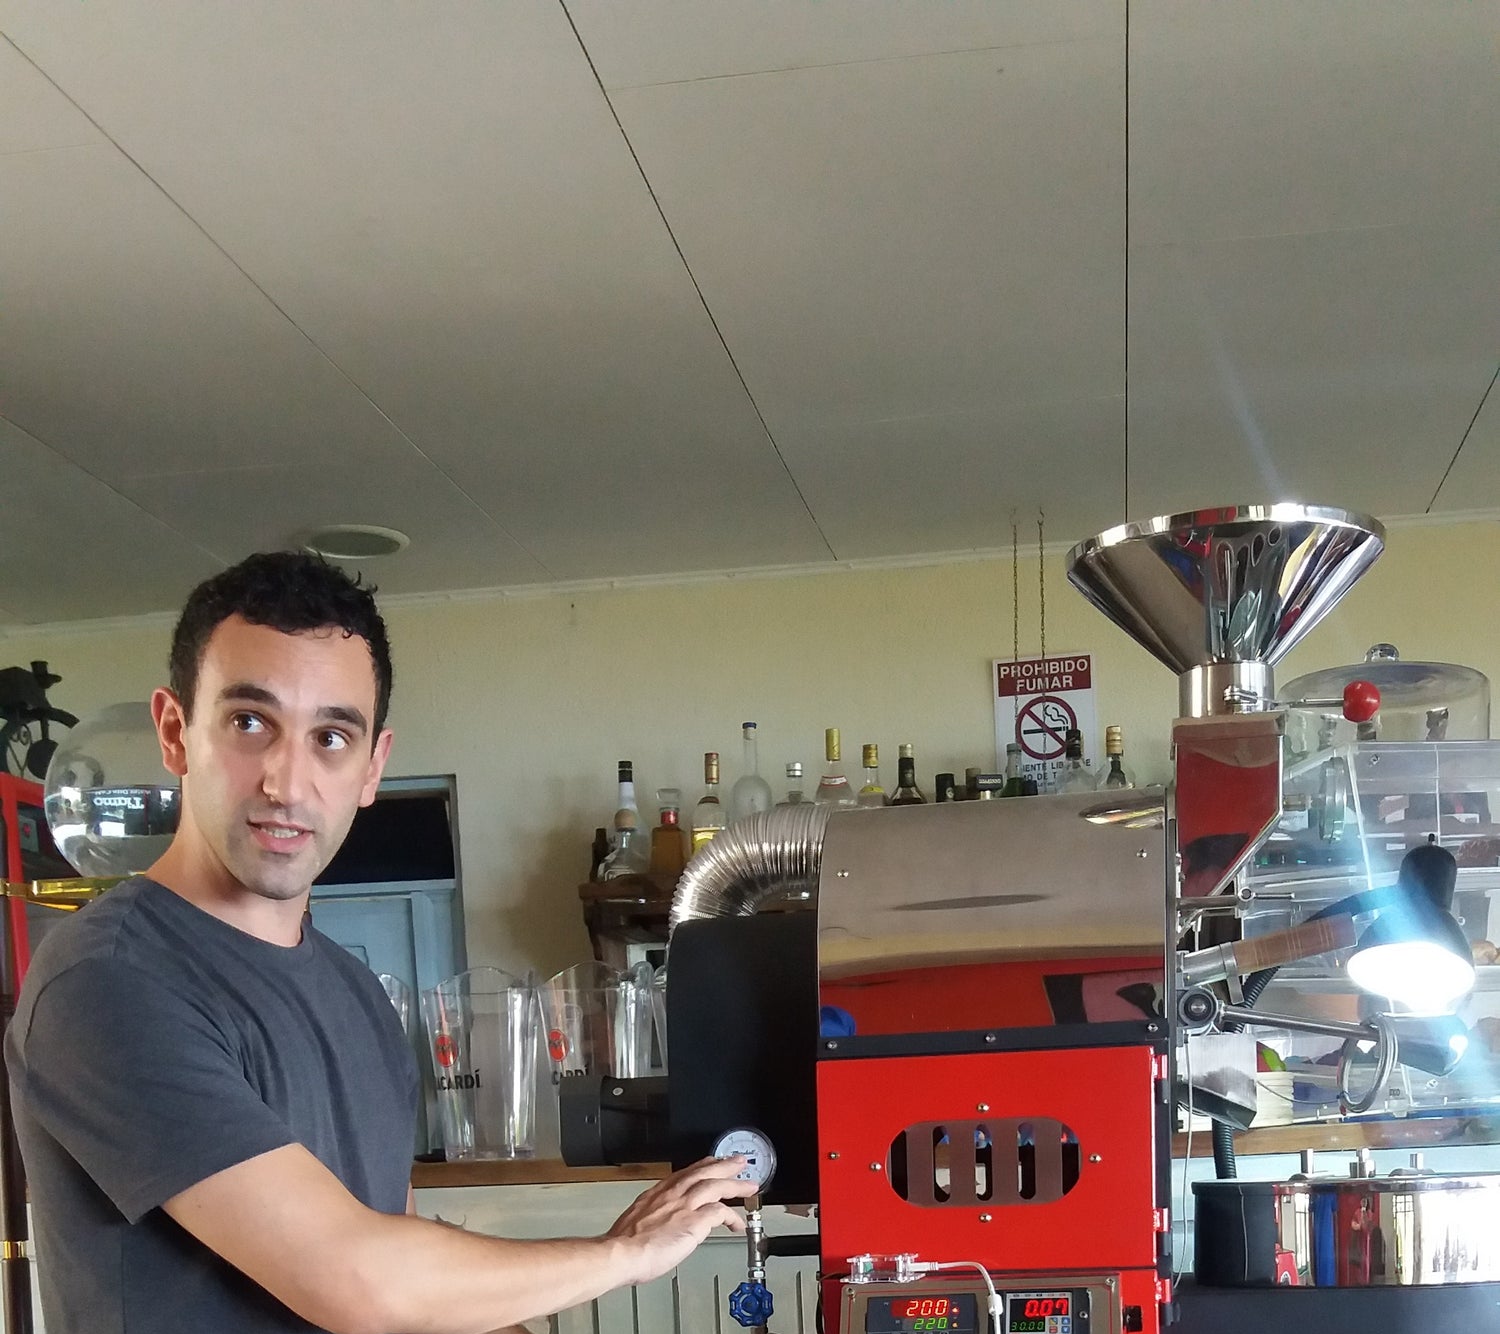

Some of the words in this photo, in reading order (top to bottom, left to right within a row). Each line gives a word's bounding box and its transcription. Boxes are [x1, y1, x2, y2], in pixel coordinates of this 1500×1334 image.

[1000, 659, 1088, 679] PROHIBIDO
[1016, 675, 1073, 692] FUMAR
[93, 797, 144, 809] Tiamo
[906, 1300, 948, 1316] 200
[914, 1318, 948, 1330] 220
[1011, 1321, 1044, 1331] 30.00
